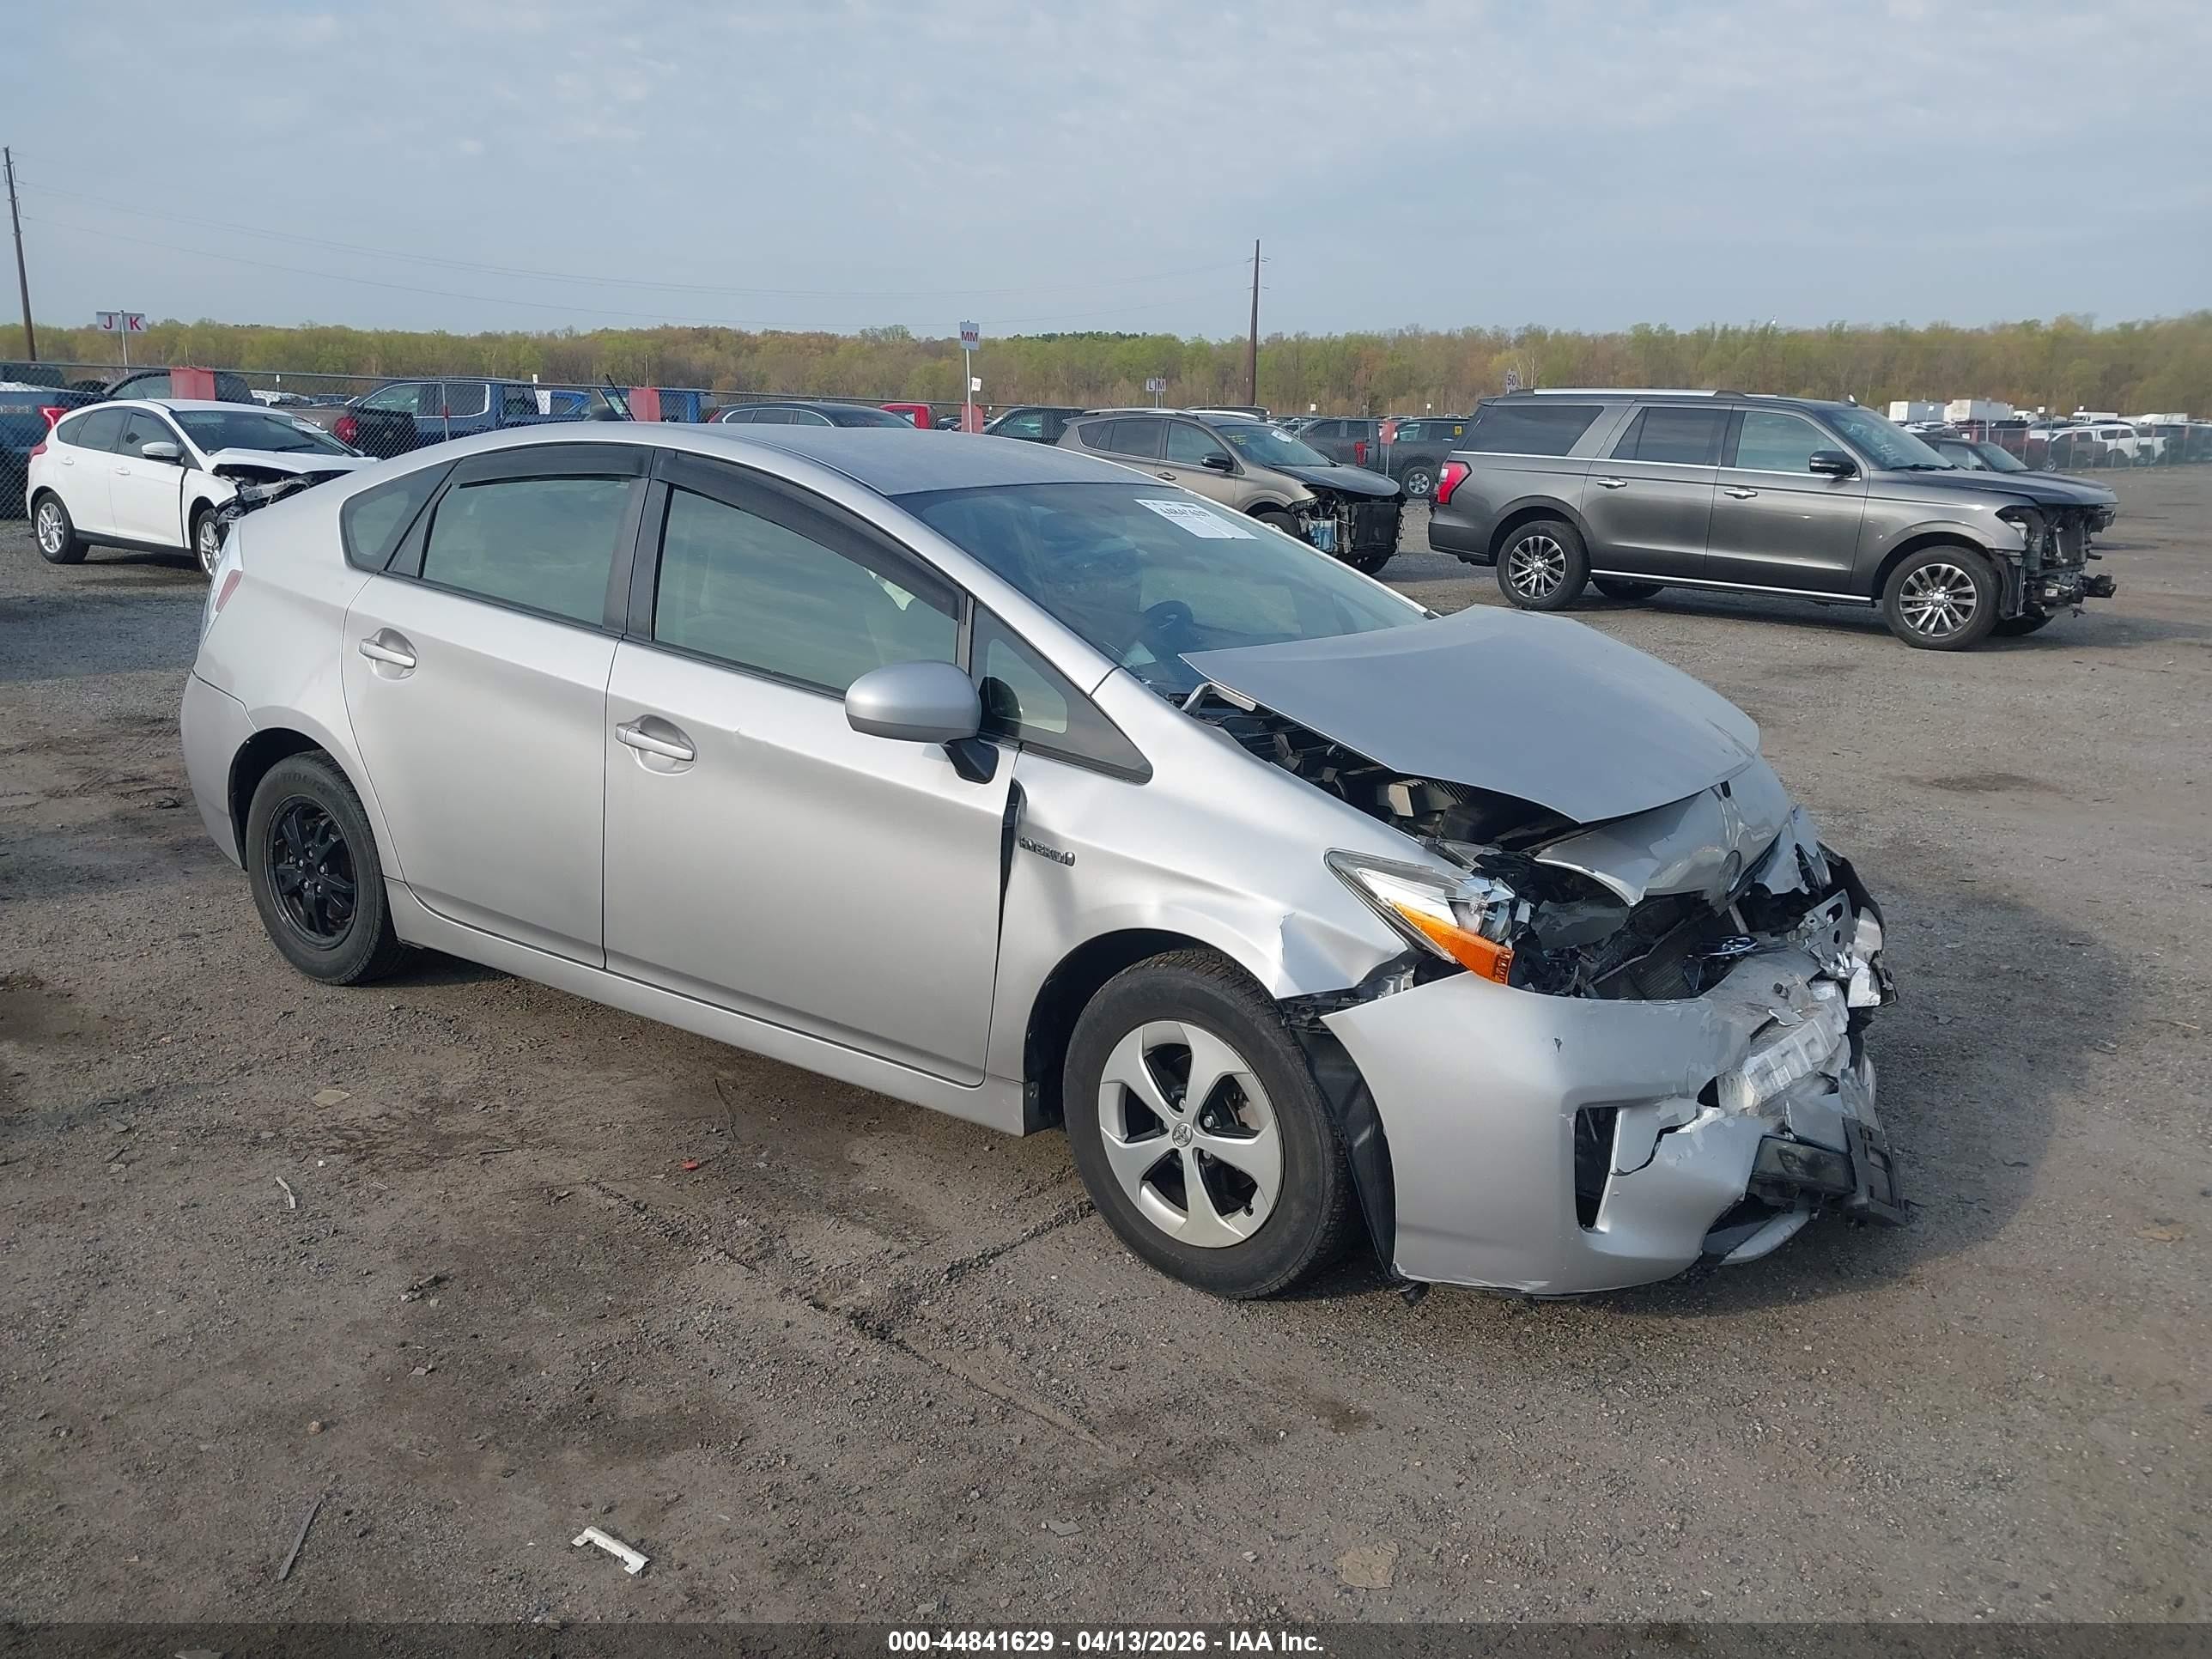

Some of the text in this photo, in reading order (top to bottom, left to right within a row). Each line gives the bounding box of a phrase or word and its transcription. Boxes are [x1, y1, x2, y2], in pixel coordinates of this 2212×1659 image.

[103, 315, 112, 330] J
[129, 316, 143, 331] K
[962, 331, 978, 343] MM
[1507, 374, 1516, 386] 50
